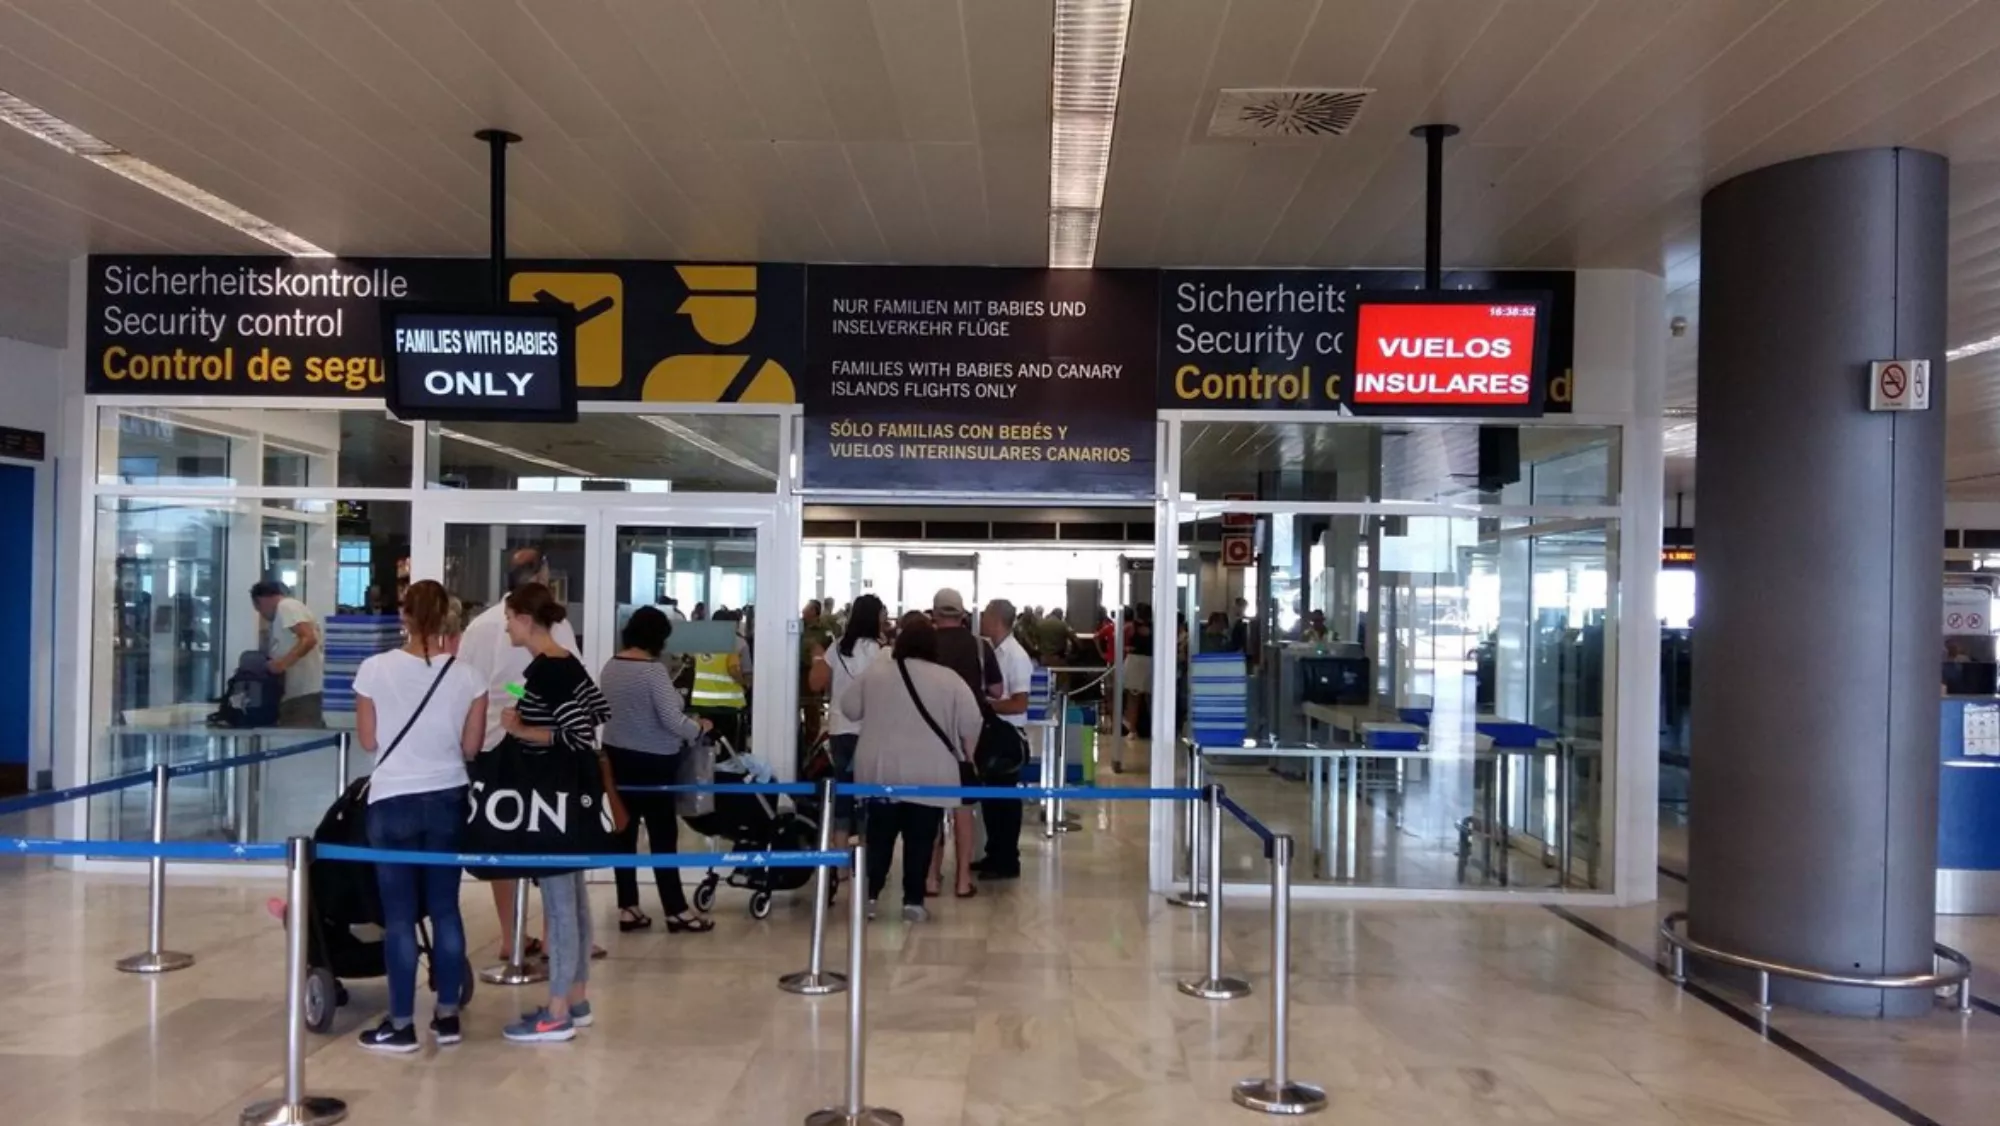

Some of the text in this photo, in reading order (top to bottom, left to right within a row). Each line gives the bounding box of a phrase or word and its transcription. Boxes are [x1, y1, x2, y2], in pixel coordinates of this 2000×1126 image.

[104, 265, 408, 297] Sicherheitskontrolle
[832, 299, 1087, 317] NUR FAMILIEN MIT BABIES UND
[1176, 282, 1347, 313] Sicherheits
[103, 306, 343, 342] Security control
[832, 318, 1010, 337] INSELVERKEHR FLÜGE
[395, 328, 558, 356] FAMILIES WITH BABIES
[1176, 324, 1304, 361] Security
[1378, 337, 1512, 358] VUELOS
[102, 346, 386, 391] Control de segu
[832, 360, 1123, 379] FAMILIES WITH BABIES AND CANARY
[424, 370, 534, 396] ONLY
[831, 381, 1017, 398] ISLANDS FLIGHTS ONLY
[1175, 364, 1310, 400] Control
[1355, 373, 1530, 393] INSULARES
[830, 418, 1068, 440] SÓLO FAMILIAS CON BEBÉS Y
[829, 442, 1131, 462] VUELOS INTERINSULARES CANARIOS
